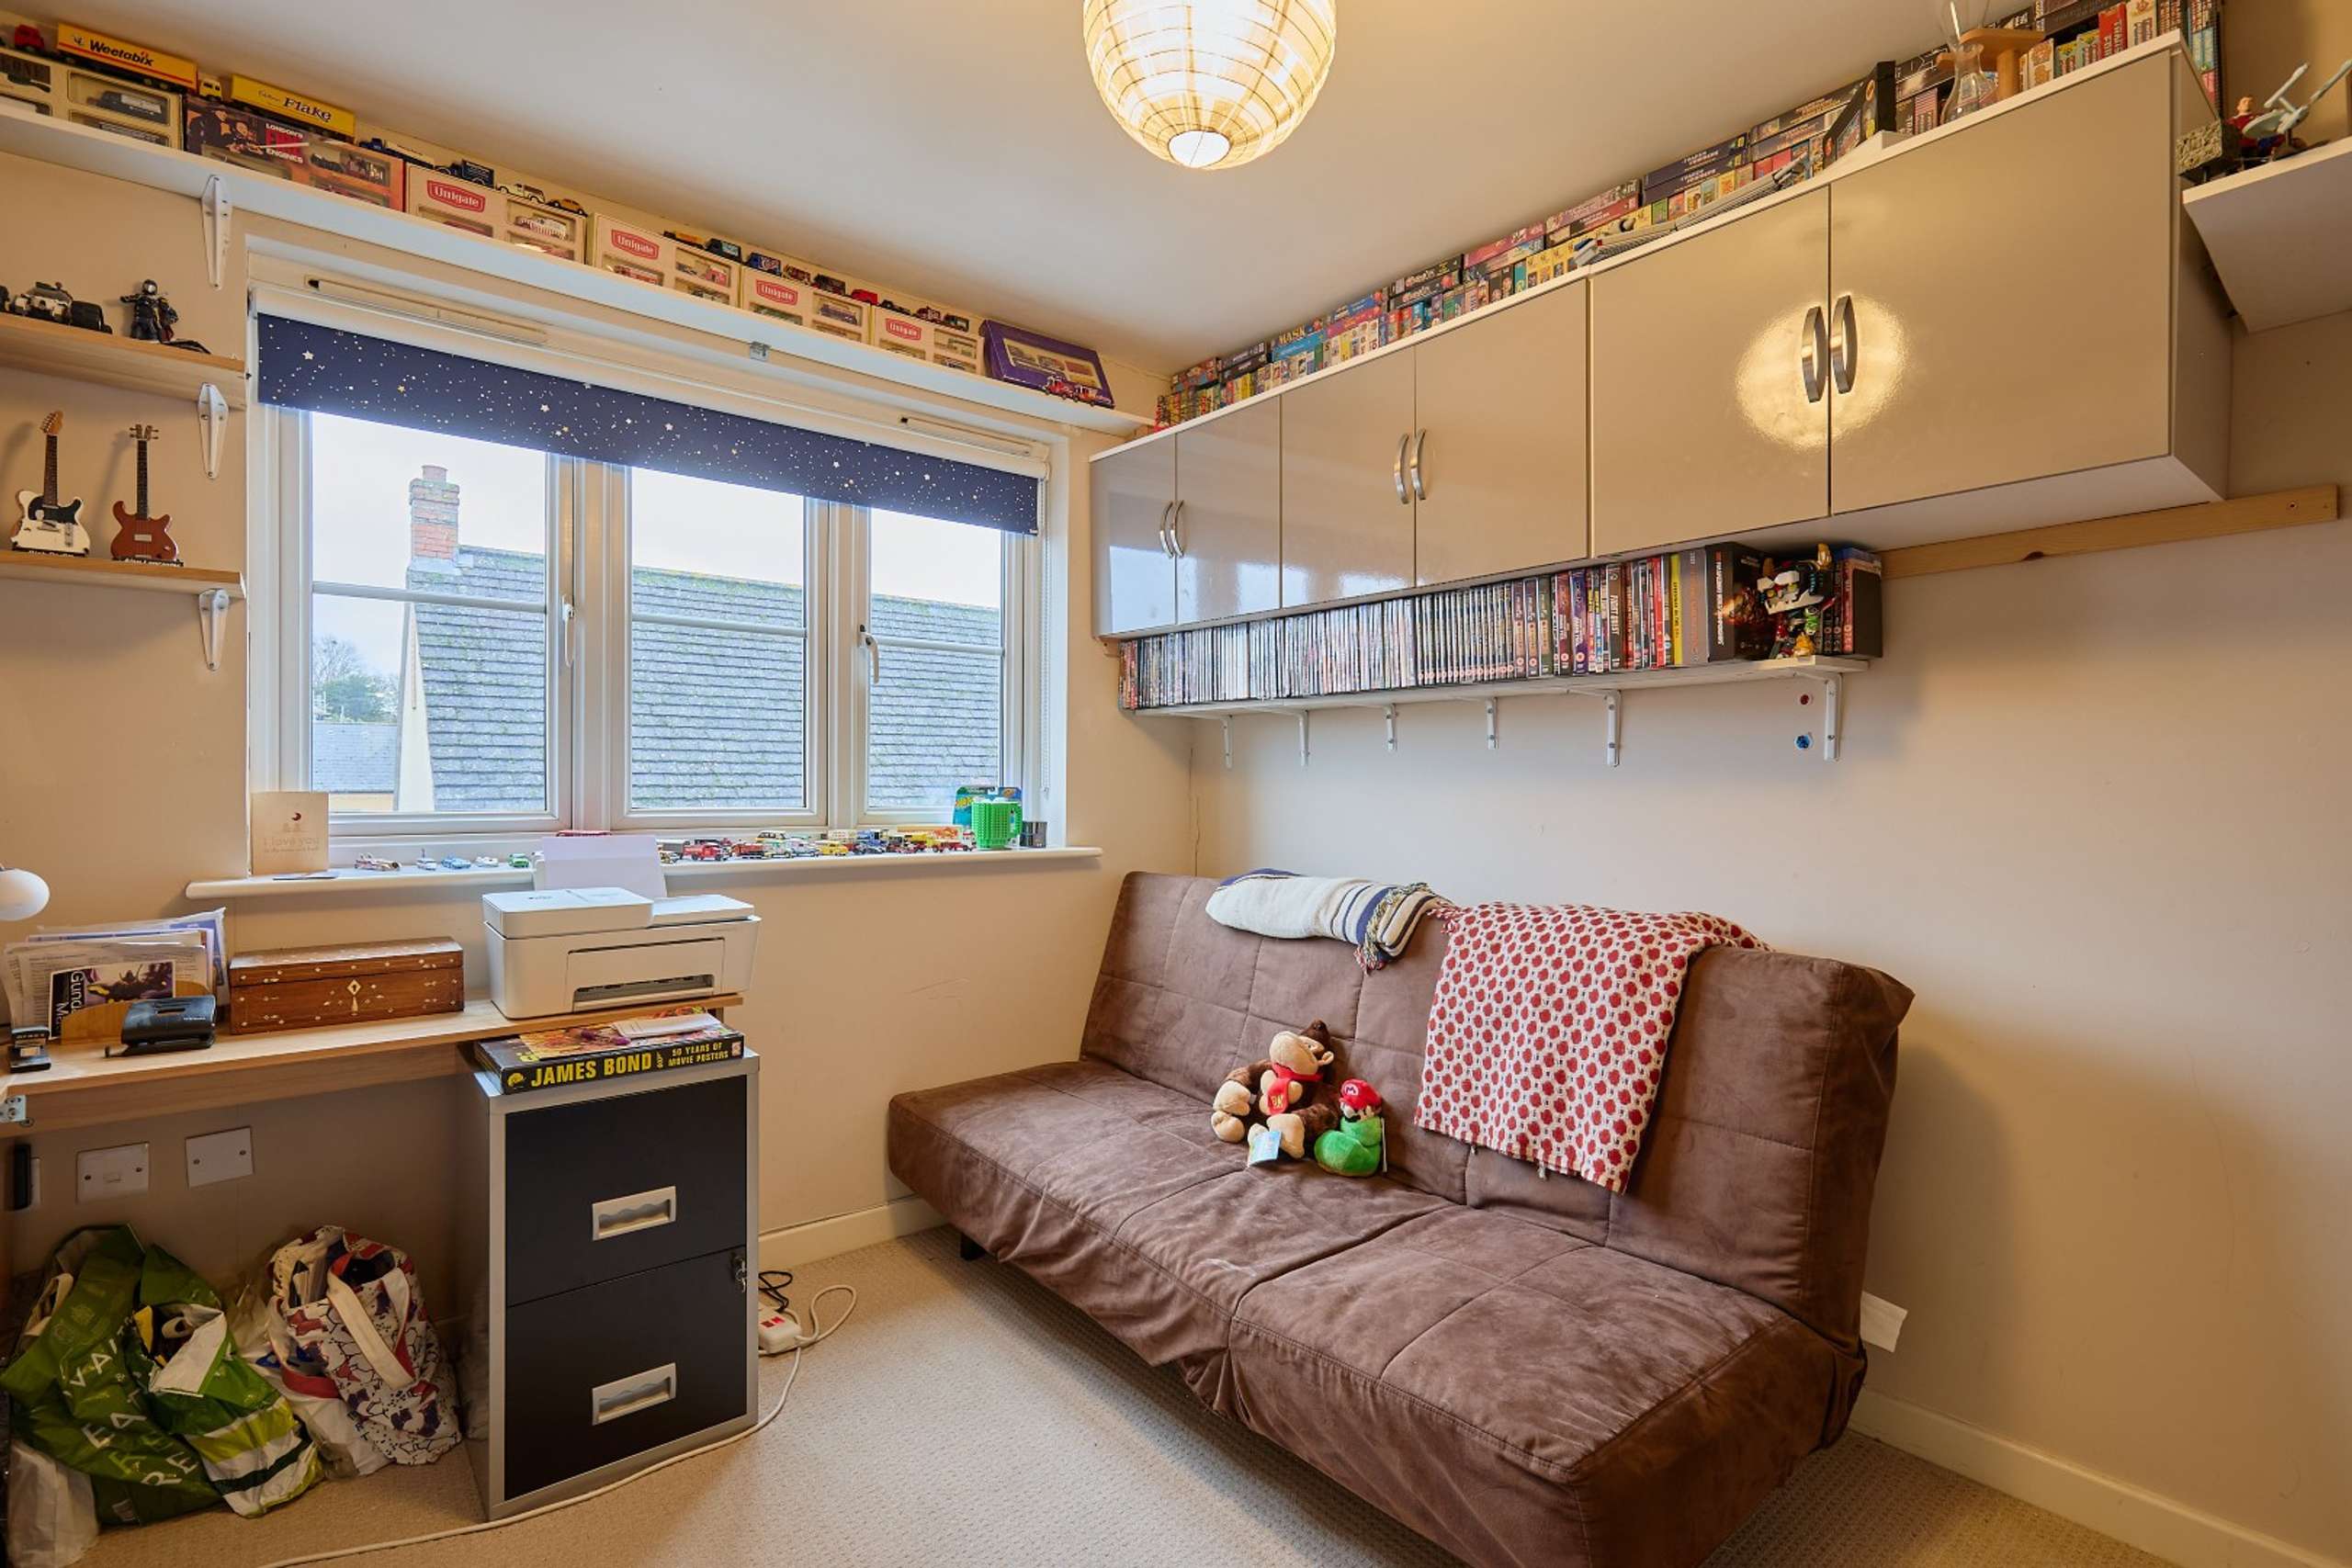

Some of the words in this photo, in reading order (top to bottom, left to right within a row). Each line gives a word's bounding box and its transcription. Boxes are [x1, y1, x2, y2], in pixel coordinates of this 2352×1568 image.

[89, 39, 153, 67] Weetabix
[284, 97, 333, 123] Flake
[434, 184, 481, 209] Unigate
[616, 233, 655, 255] Unigate
[760, 283, 795, 303] Unigate
[668, 1056, 695, 1067] MOVIE
[695, 1051, 729, 1063] POSTERS
[685, 1043, 710, 1055] YEARS
[530, 1060, 596, 1088] JAMES
[604, 1052, 651, 1077] BOND
